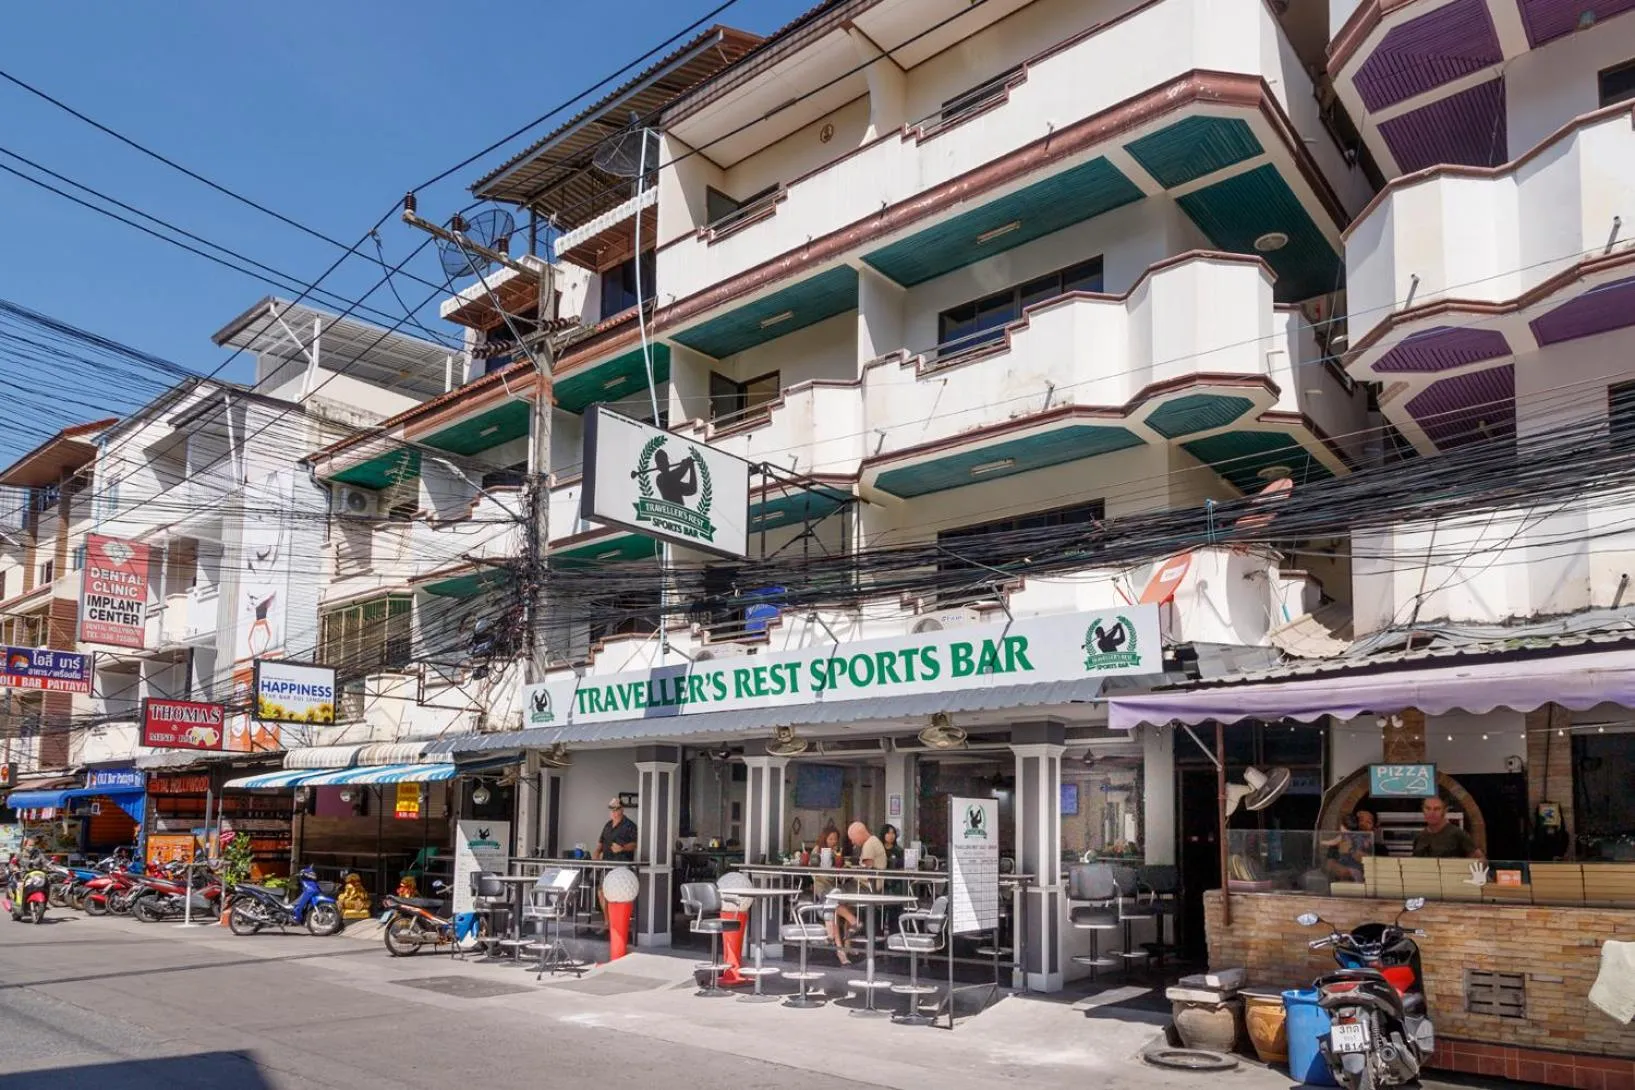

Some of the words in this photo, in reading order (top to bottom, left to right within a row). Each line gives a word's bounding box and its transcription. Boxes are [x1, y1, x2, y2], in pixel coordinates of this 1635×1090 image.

[652, 518, 682, 534] SPORTS
[683, 527, 699, 539] BAR
[688, 514, 704, 527] REST
[90, 567, 144, 586] DENTAL
[92, 581, 138, 597] CLINIC
[87, 594, 142, 614] IMPLANT
[89, 609, 139, 626] CENTER
[576, 671, 729, 713] TRAVELLER'S
[733, 662, 802, 698] REST
[810, 646, 942, 691] SPORTS
[950, 635, 1034, 678] BAR
[21, 676, 42, 688] BAR
[47, 678, 88, 692] PATTAYA
[261, 680, 332, 698] HAPPINESS
[148, 704, 222, 725] THOMAS
[1377, 766, 1429, 778] PIZZA
